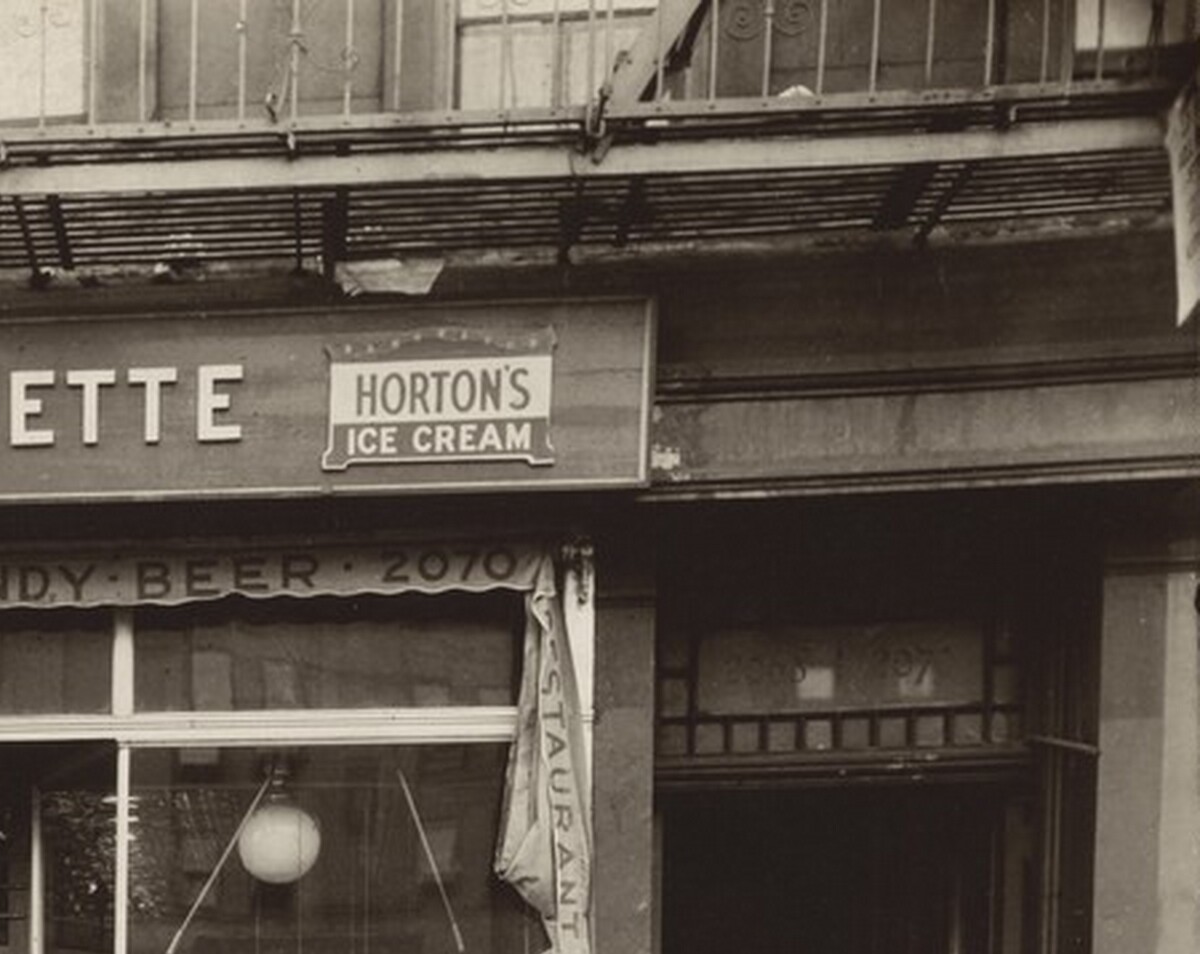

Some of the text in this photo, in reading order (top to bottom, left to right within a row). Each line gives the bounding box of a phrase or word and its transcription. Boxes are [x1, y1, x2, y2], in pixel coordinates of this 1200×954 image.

[355, 365, 532, 418] HORTON'S
[346, 422, 532, 456] ICE CREAM
[137, 554, 319, 600] BEER
[382, 550, 518, 583] 2070
